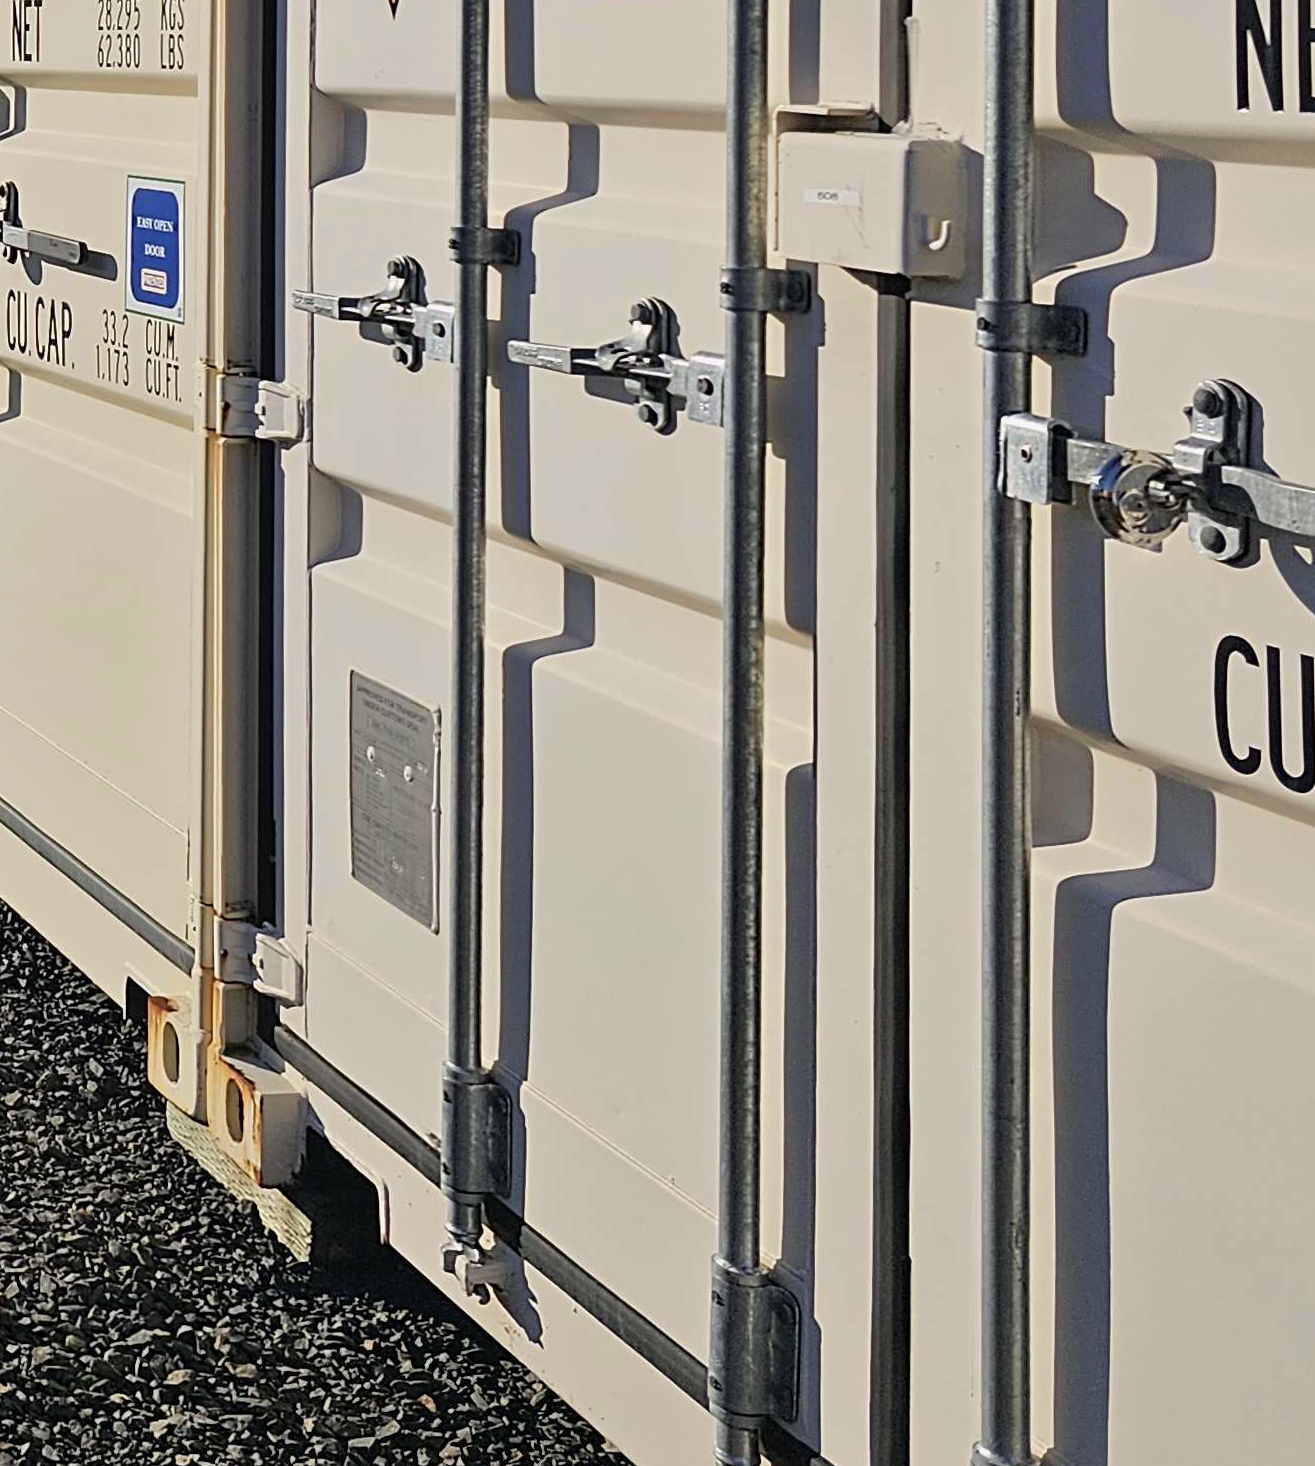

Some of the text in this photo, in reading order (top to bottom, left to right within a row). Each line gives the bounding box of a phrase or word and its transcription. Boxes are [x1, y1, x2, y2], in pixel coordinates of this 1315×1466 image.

[12, 0, 43, 63] NET
[160, 33, 185, 71] LBS
[136, 216, 174, 233] EASY OPEN
[144, 243, 166, 259] DOOR
[102, 309, 130, 349] 33.2
